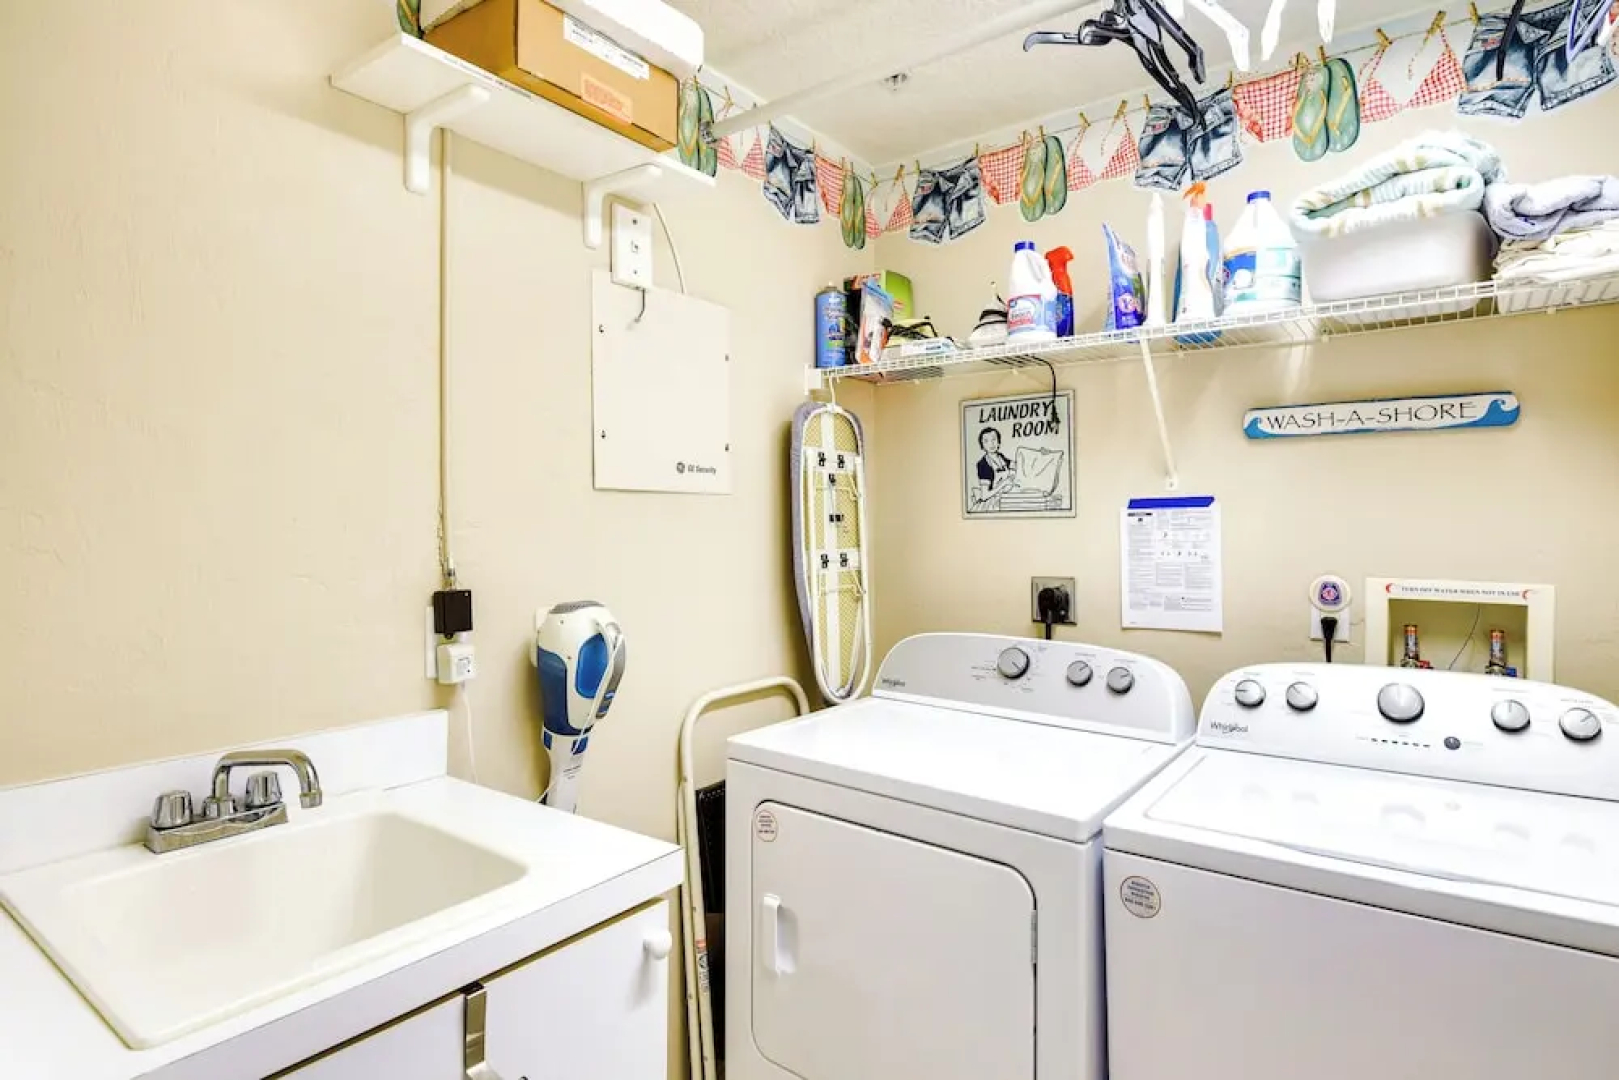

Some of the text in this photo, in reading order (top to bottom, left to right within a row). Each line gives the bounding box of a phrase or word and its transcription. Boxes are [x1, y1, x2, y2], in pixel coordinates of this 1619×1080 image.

[978, 400, 1054, 424] LAUNDRY
[1266, 401, 1478, 431] WASH-A-SHORE
[1012, 419, 1060, 438] ROOM
[1210, 721, 1249, 734] Whirlpool
